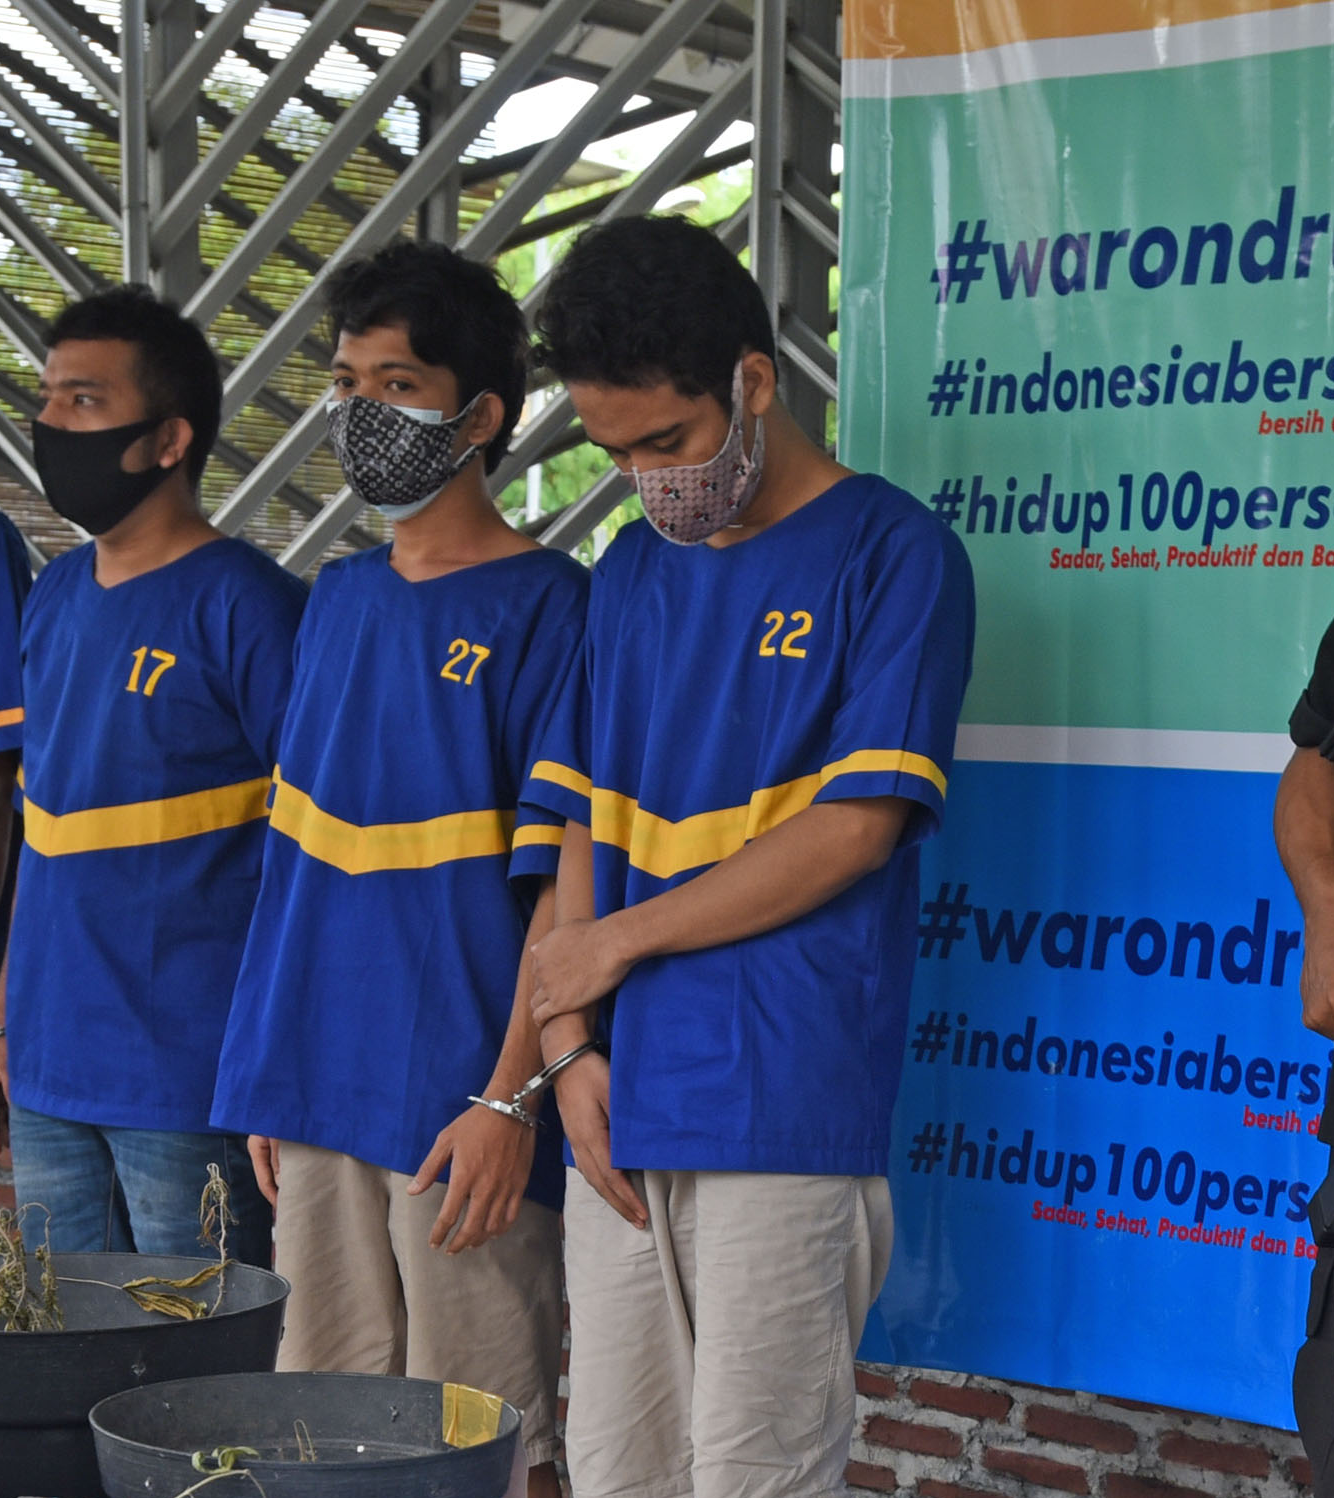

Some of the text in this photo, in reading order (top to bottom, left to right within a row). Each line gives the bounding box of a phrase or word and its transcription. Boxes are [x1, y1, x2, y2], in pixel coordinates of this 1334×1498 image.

[1258, 409, 1325, 435] bersih
[1049, 547, 1106, 572] Sadar,
[1110, 545, 1161, 572] Sehat,
[1166, 543, 1259, 568] Produktif
[1262, 543, 1305, 568] dan
[758, 609, 813, 659] 22
[124, 645, 176, 696] 17
[440, 637, 491, 685] 27
[916, 882, 1302, 988] #warondr
[1242, 1105, 1302, 1135] bersih
[906, 1122, 1311, 1224] #hidup100pers
[1031, 1200, 1089, 1230] Sadar,
[1094, 1209, 1151, 1239] Sehat,
[1157, 1218, 1248, 1249] Produktif
[1250, 1230, 1288, 1256] dan
